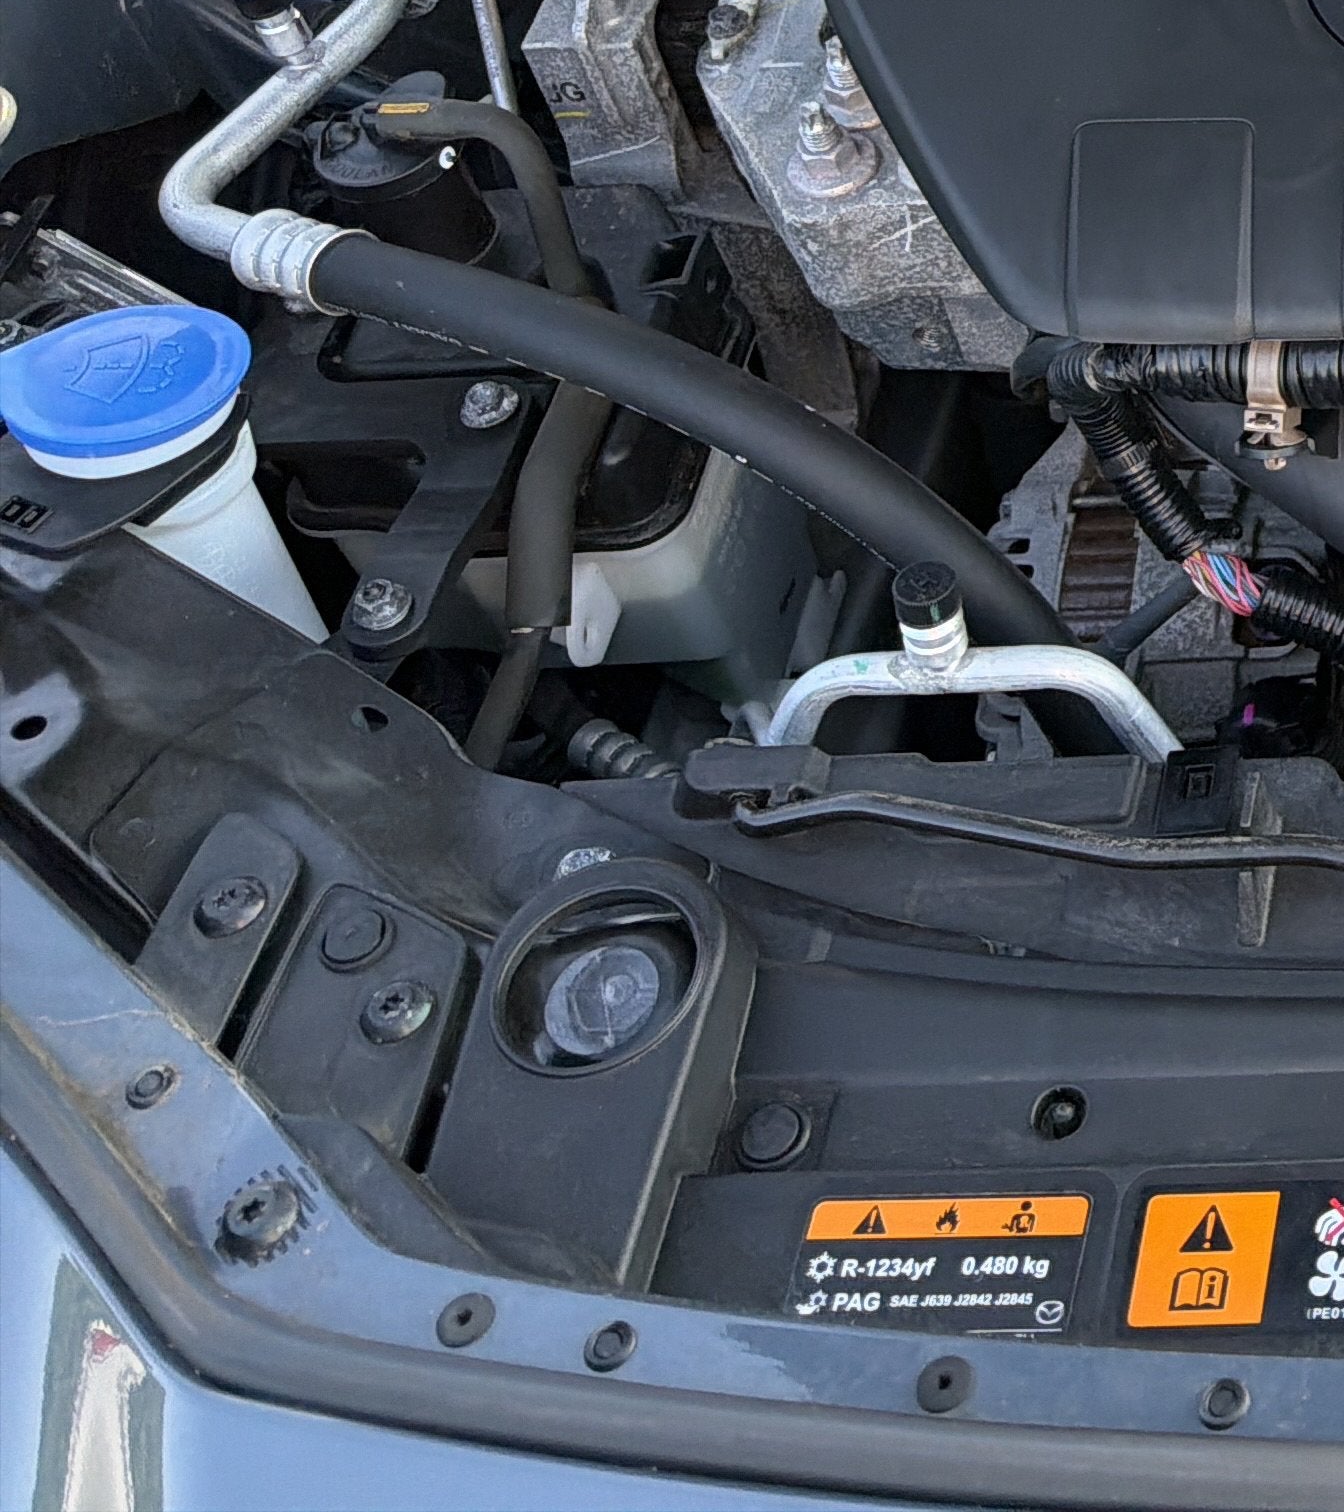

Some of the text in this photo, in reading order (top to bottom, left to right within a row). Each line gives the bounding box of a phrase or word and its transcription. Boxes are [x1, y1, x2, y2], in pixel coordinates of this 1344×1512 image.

[840, 1255, 1050, 1280] R-1234yf 0.480 kg
[832, 1291, 1034, 1312] PAG SAE J639 J2842 J2845
